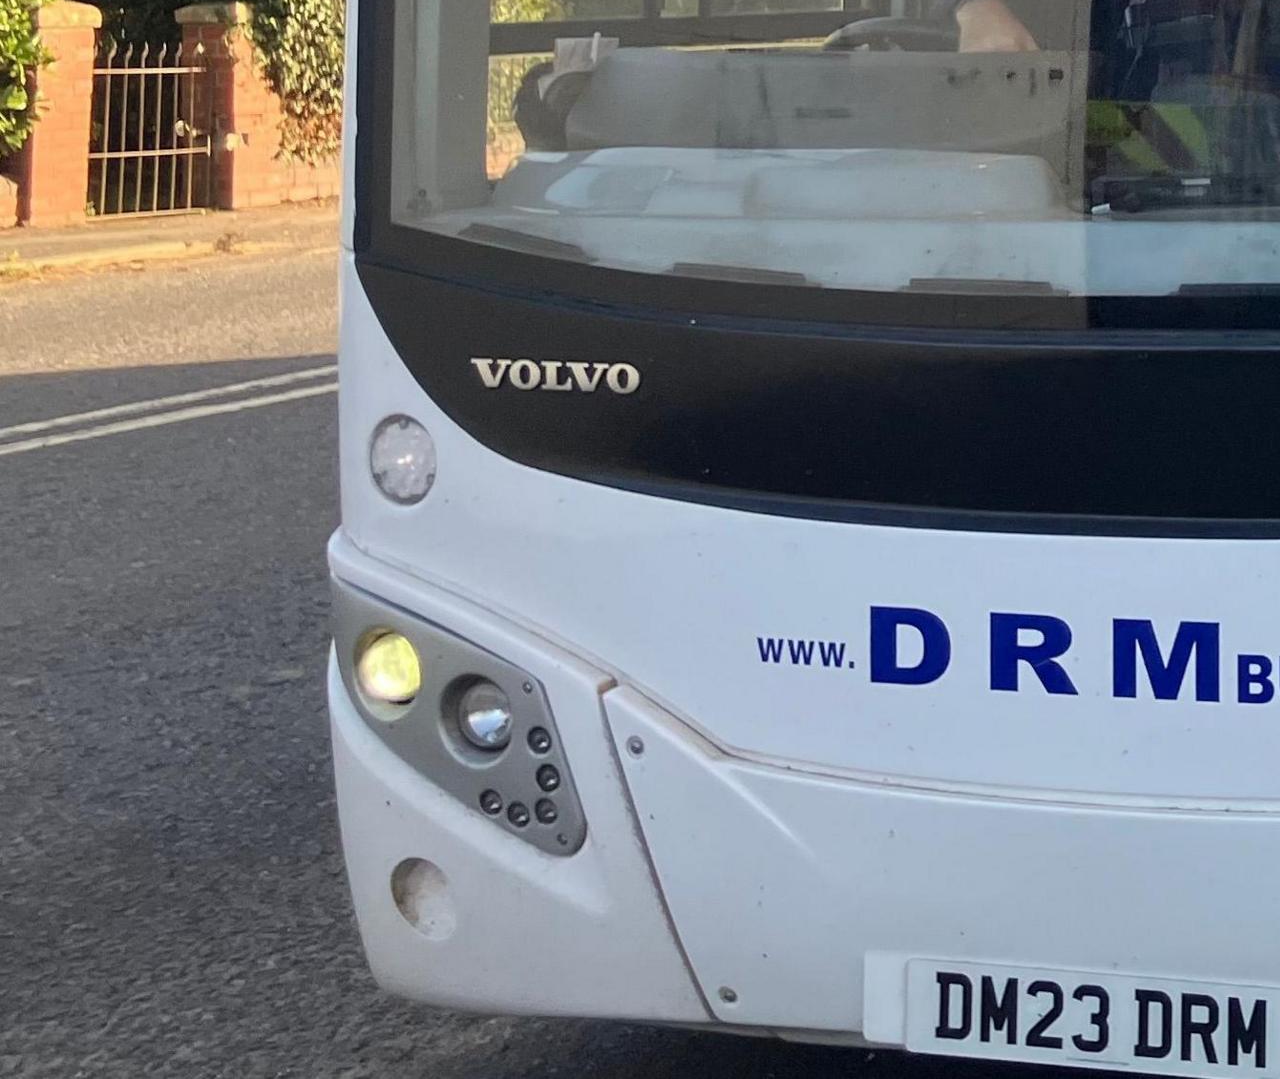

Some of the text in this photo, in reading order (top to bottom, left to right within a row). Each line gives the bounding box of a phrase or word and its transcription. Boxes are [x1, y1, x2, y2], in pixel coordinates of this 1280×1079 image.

[470, 357, 641, 395] VOLVO
[935, 971, 1267, 1069] DM23 DRM
